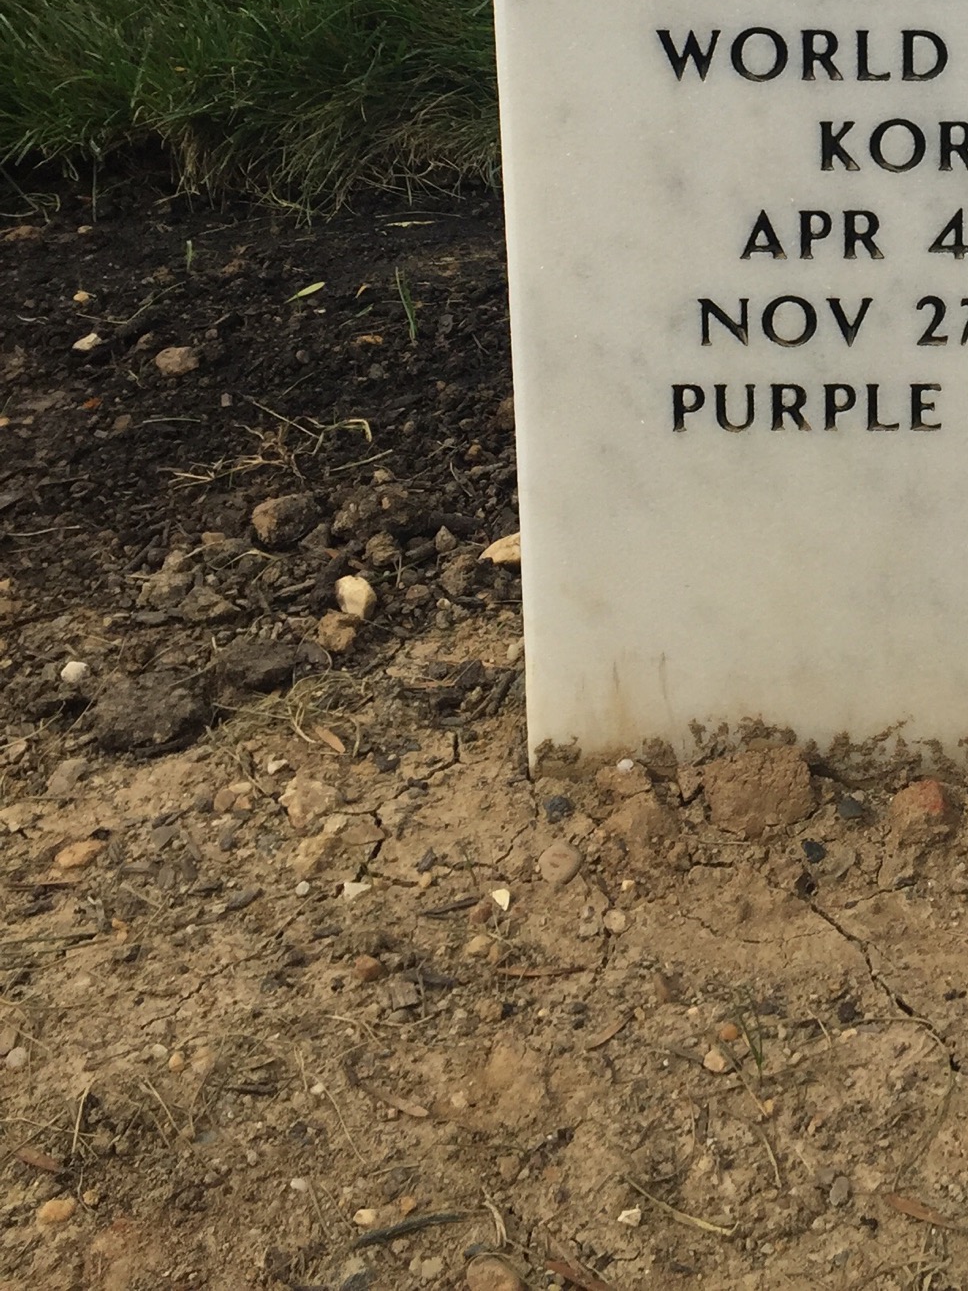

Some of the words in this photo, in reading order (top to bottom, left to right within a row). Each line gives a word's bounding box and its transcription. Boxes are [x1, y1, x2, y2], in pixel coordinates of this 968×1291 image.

[656, 27, 948, 82] WORLD
[740, 210, 884, 259] APR
[698, 295, 873, 347] NOV
[671, 384, 941, 432] PURPLE
